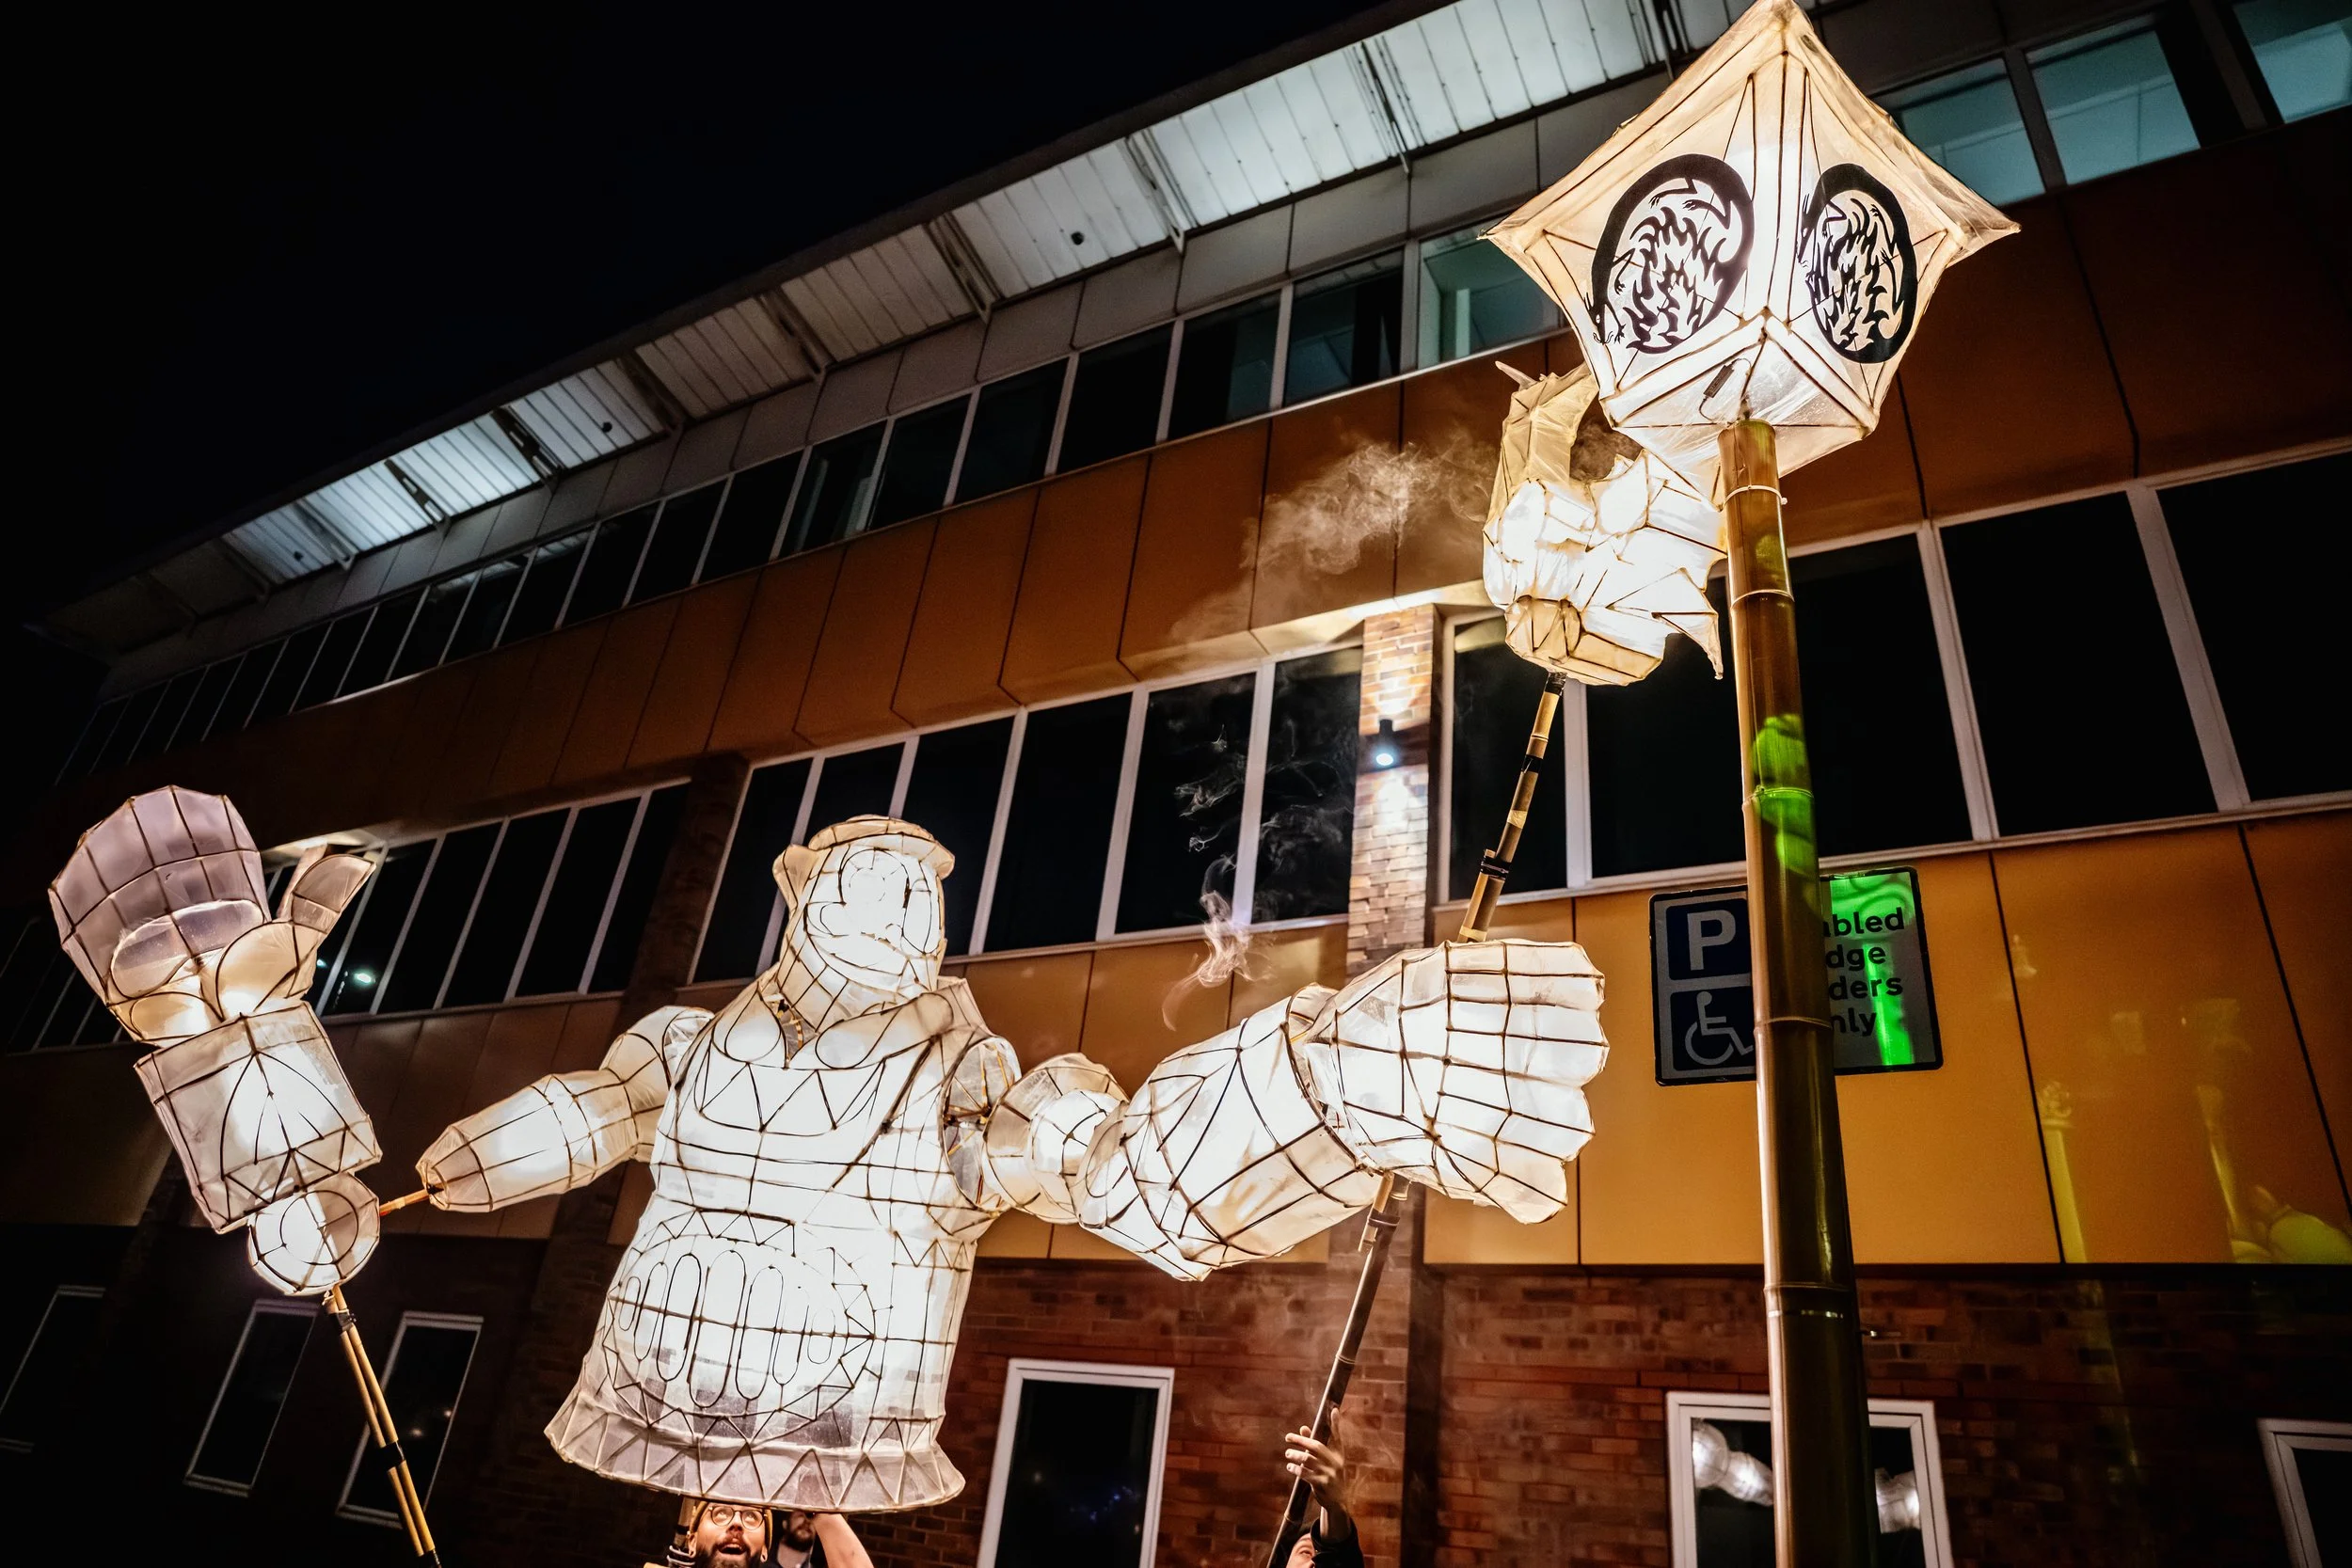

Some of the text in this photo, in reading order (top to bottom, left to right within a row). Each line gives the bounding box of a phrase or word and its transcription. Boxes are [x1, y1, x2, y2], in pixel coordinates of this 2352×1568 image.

[1823, 907, 1904, 937] bled
[1687, 910, 1737, 971] P
[1825, 944, 1886, 972] dge
[1829, 975, 1903, 1001] ders
[1831, 1007, 1877, 1037] nly
